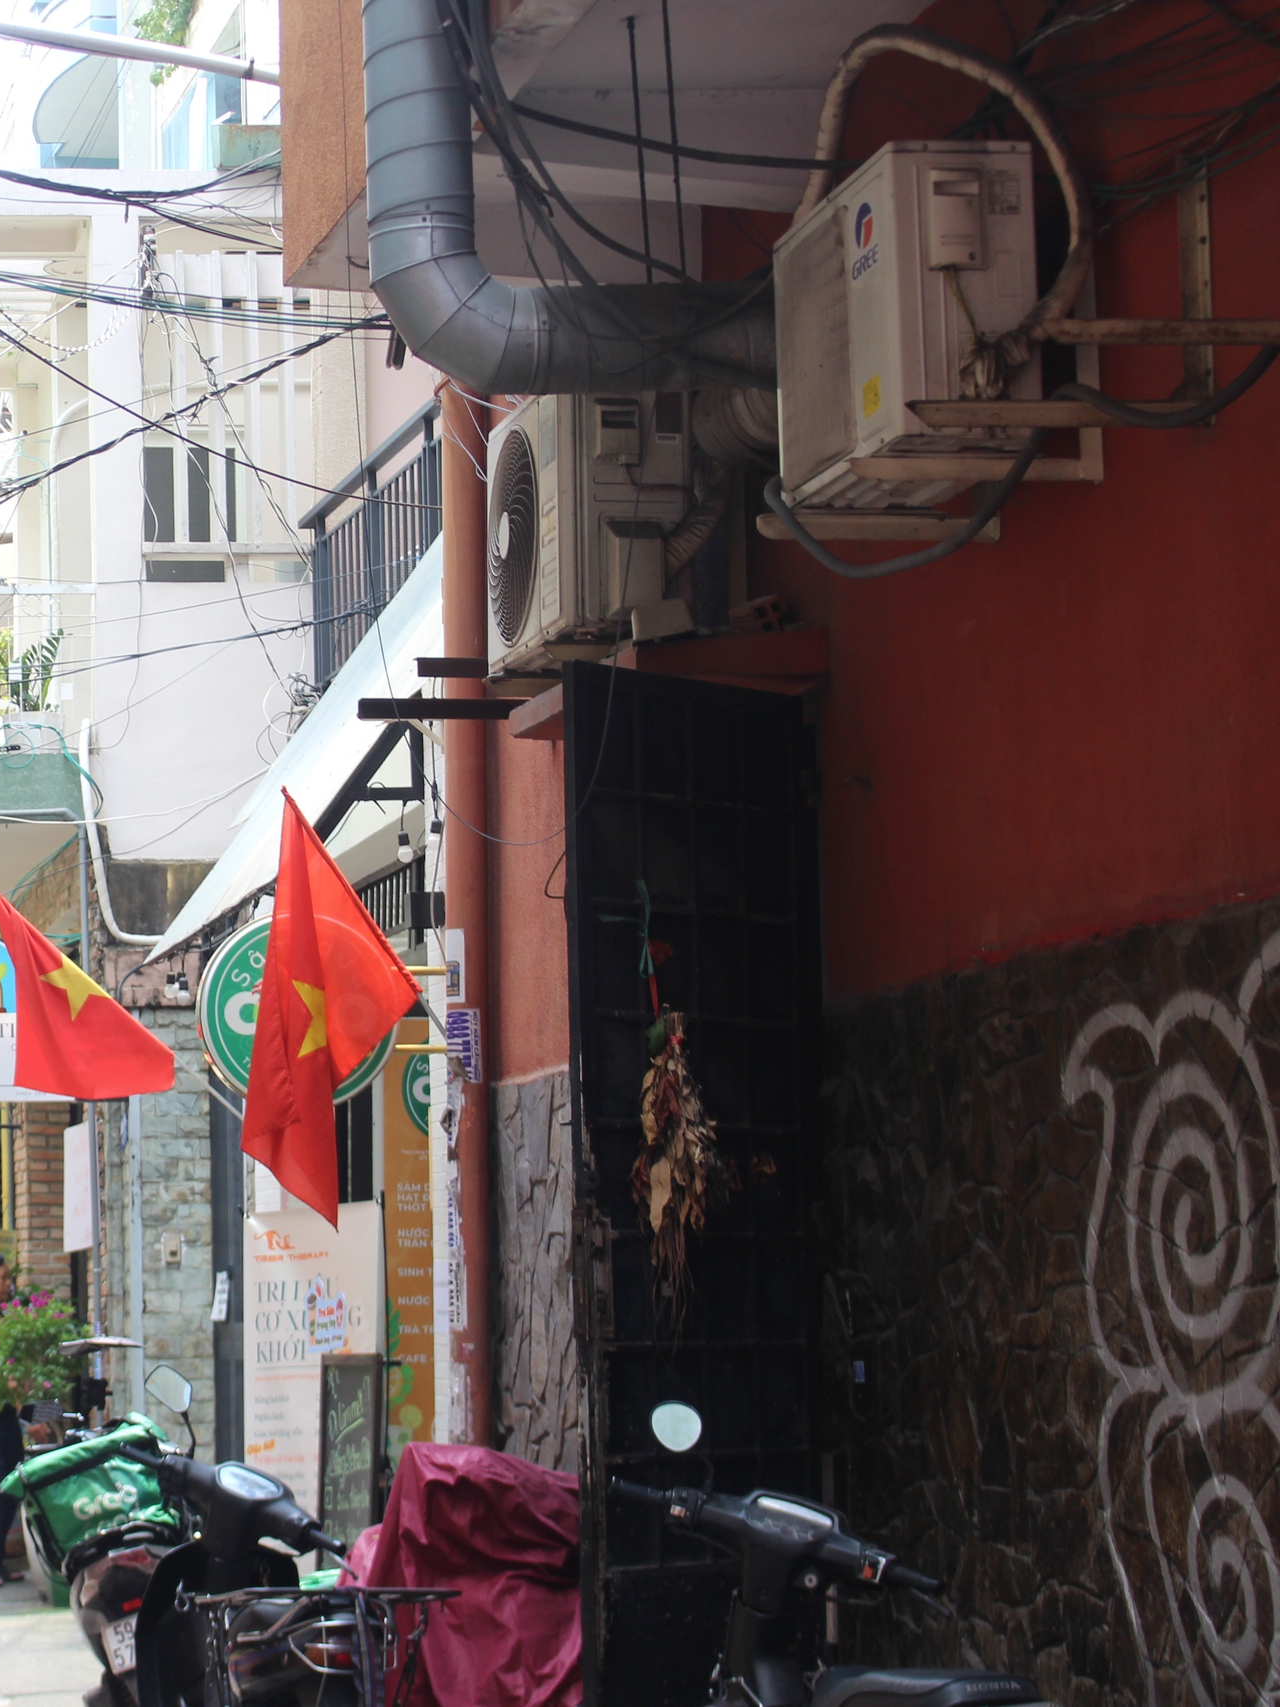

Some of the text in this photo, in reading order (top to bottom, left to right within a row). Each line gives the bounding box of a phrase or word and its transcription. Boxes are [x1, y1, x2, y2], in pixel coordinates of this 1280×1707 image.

[852, 244, 879, 281] GREE
[253, 1250, 329, 1263] TIGER THERAPY
[397, 1267, 424, 1277] SINH
[397, 1295, 431, 1305] NƯỚC
[255, 1309, 281, 1333] CƠ
[398, 1353, 427, 1364] CAFE
[73, 1483, 138, 1520] Grab
[113, 1621, 134, 1644] 59
[113, 1643, 134, 1667] 57
[966, 1681, 1021, 1692] HONDA
